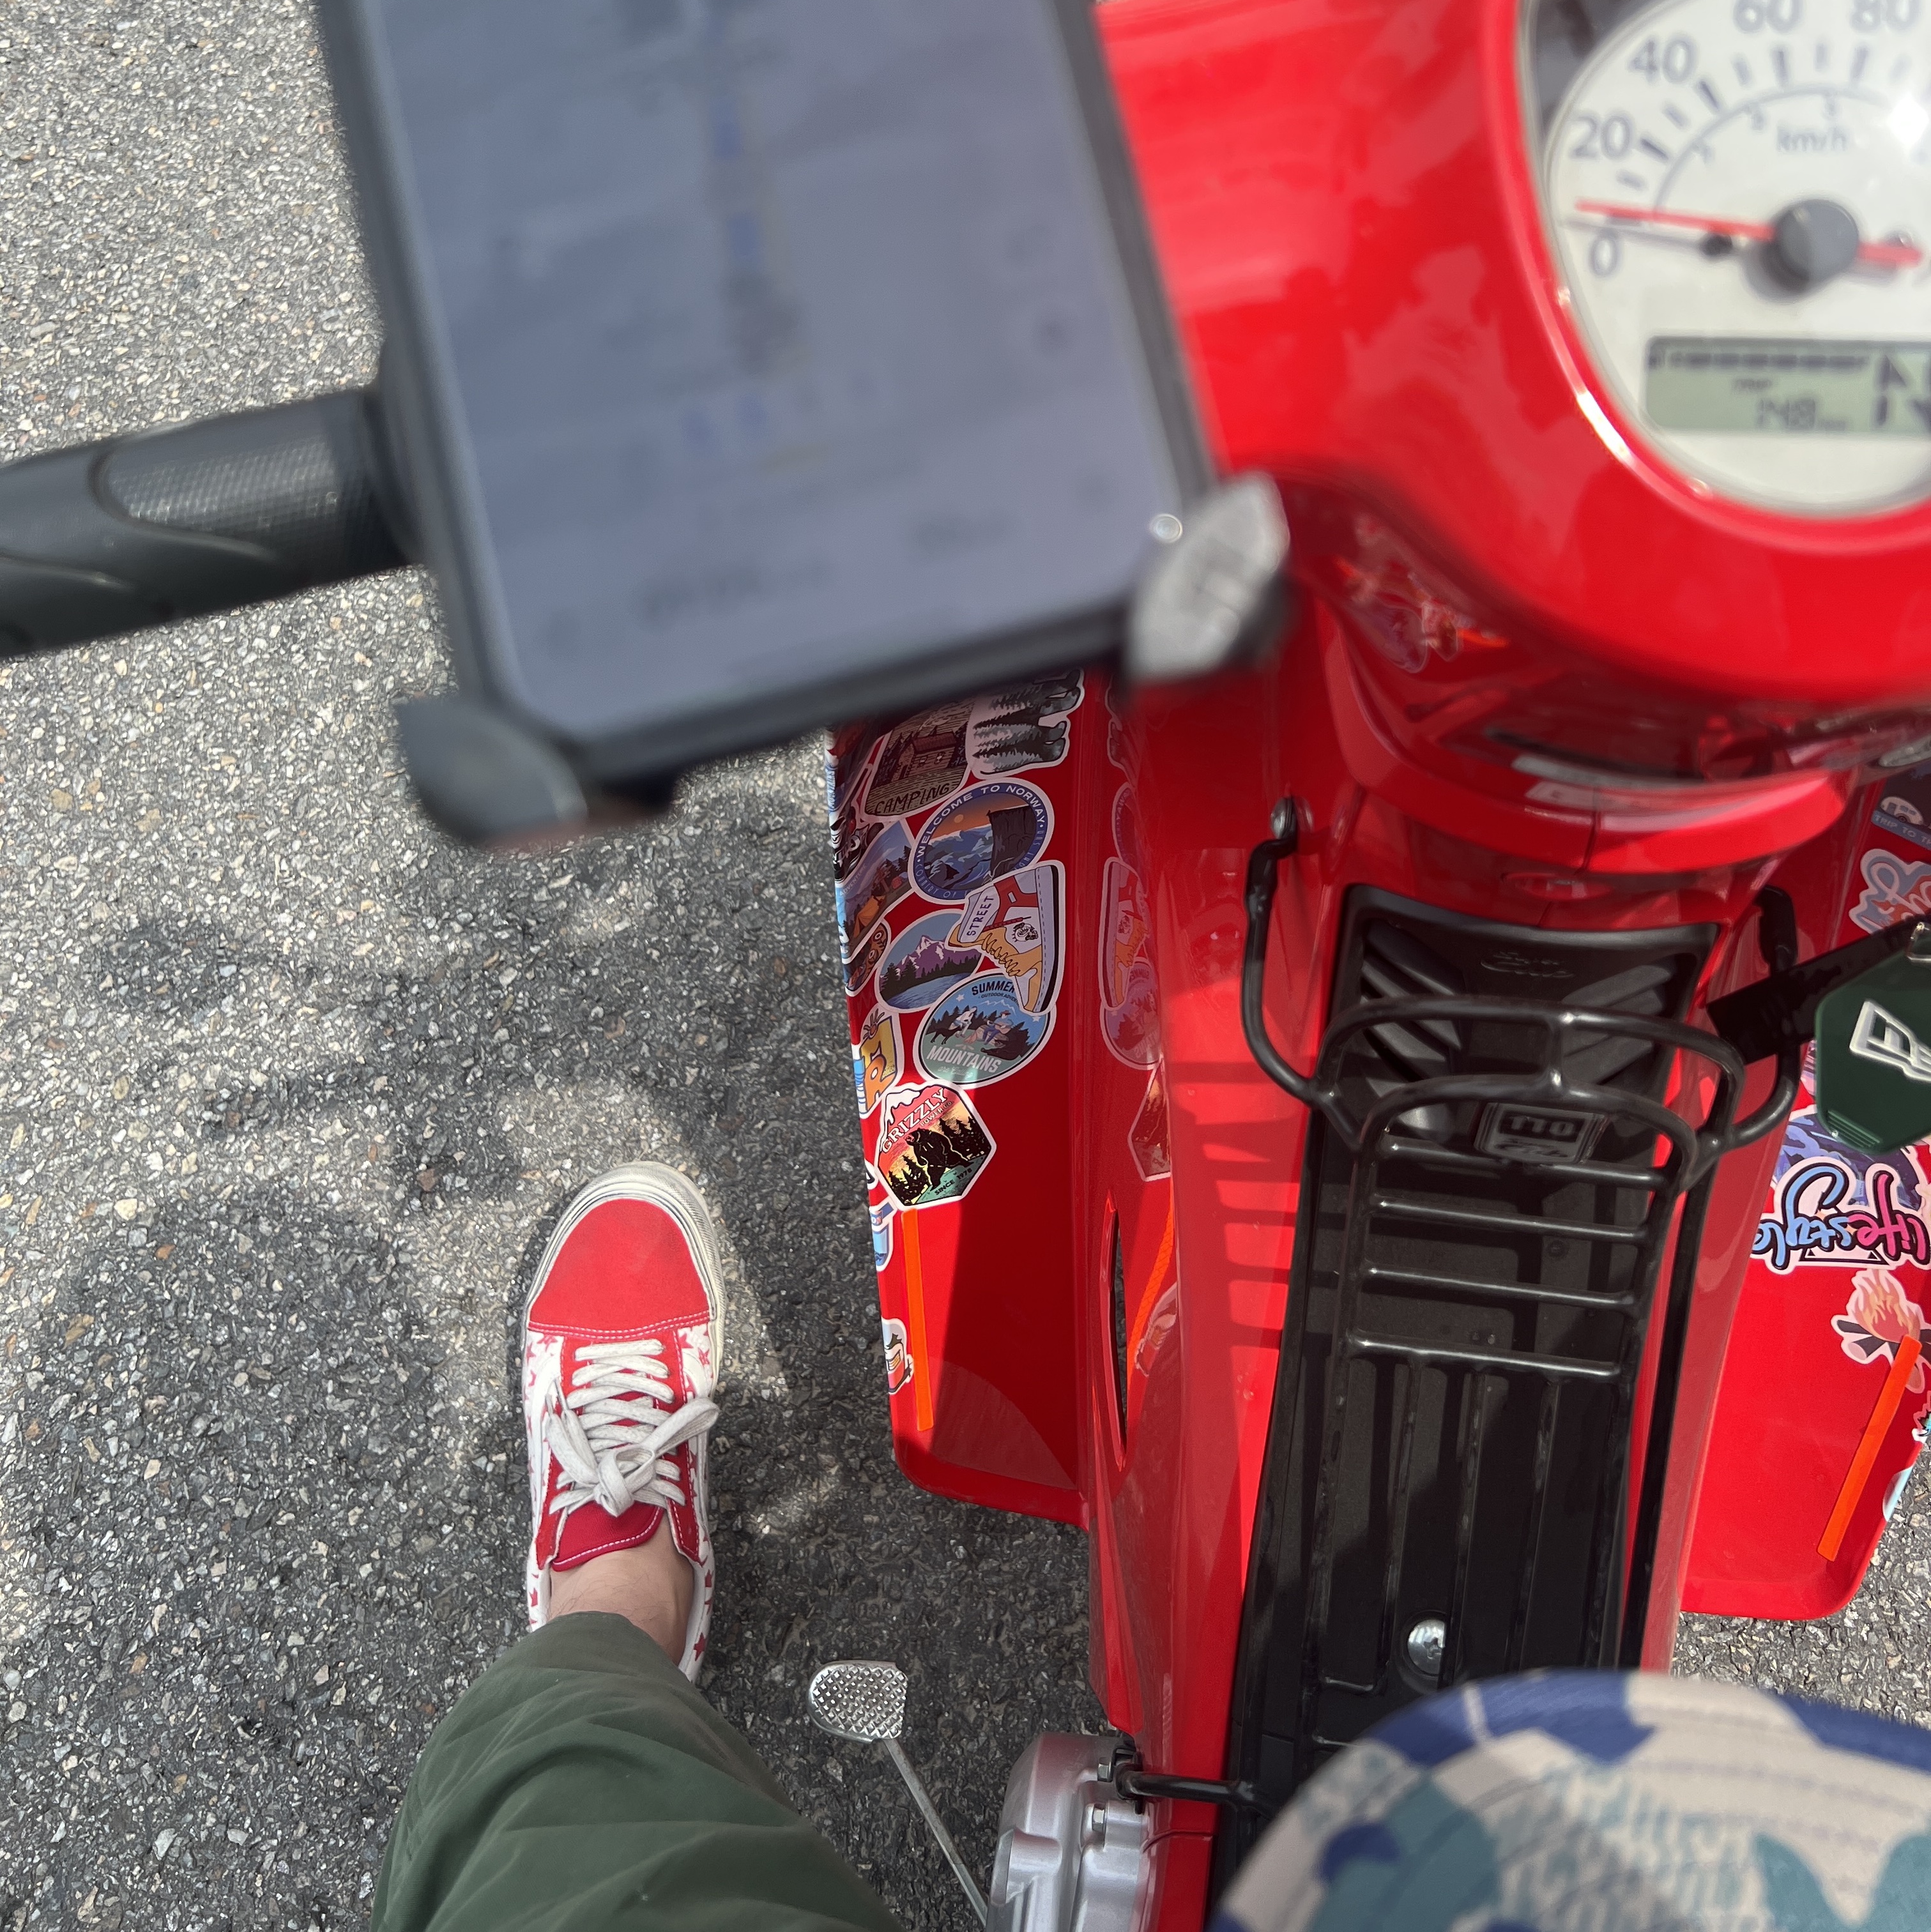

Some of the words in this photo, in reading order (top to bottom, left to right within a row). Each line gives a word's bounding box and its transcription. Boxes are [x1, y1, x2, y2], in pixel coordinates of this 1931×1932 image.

[1629, 36, 1698, 82] 40
[1569, 111, 1631, 159] 20
[1589, 228, 1621, 275] 0
[874, 783, 949, 814] CAMPING
[917, 793, 973, 858] WELCOME
[981, 785, 1000, 795] TO
[1005, 785, 1045, 824] NORWAY
[1875, 814, 1898, 827] TRIP
[1902, 826, 1916, 837] TO
[966, 895, 994, 936] STREET
[926, 1045, 1002, 1073] MOUNTAINS
[882, 1088, 947, 1153] GRIZZLY
[920, 1107, 944, 1127] POWER
[1509, 1115, 1575, 1136] 110
[935, 1179, 955, 1195] SINCE
